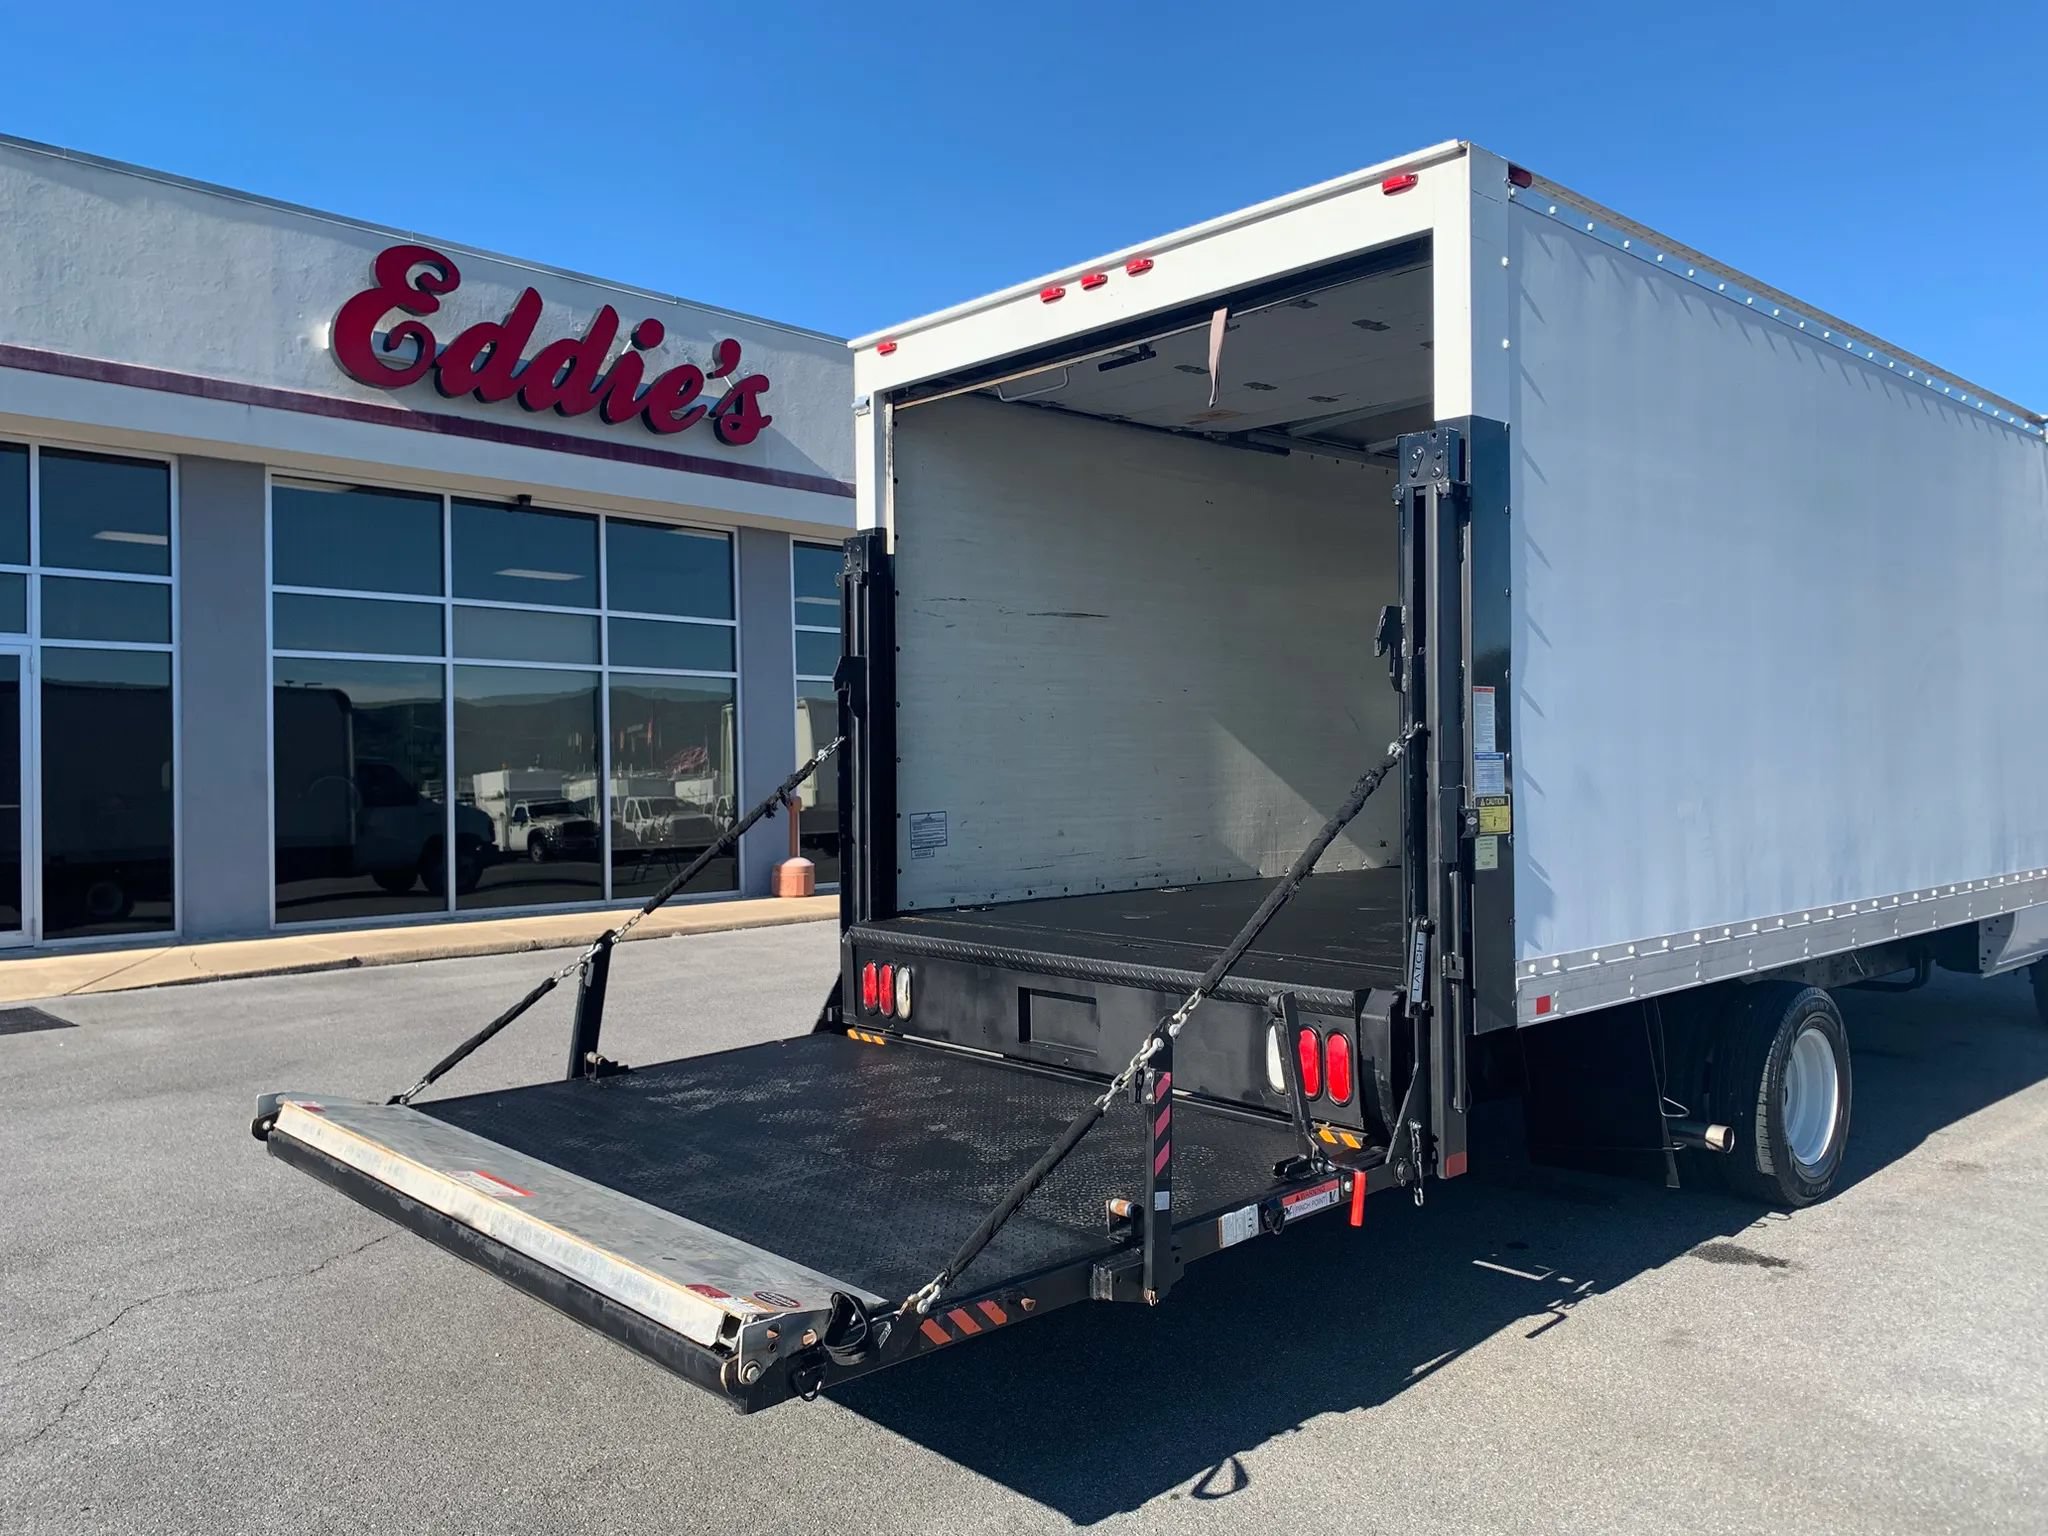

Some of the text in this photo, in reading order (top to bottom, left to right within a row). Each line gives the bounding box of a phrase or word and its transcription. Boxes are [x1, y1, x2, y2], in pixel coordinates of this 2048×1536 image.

[329, 244, 773, 446] Eddie's
[1485, 797, 1505, 806] CAUTION
[1413, 943, 1424, 991] LATCH
